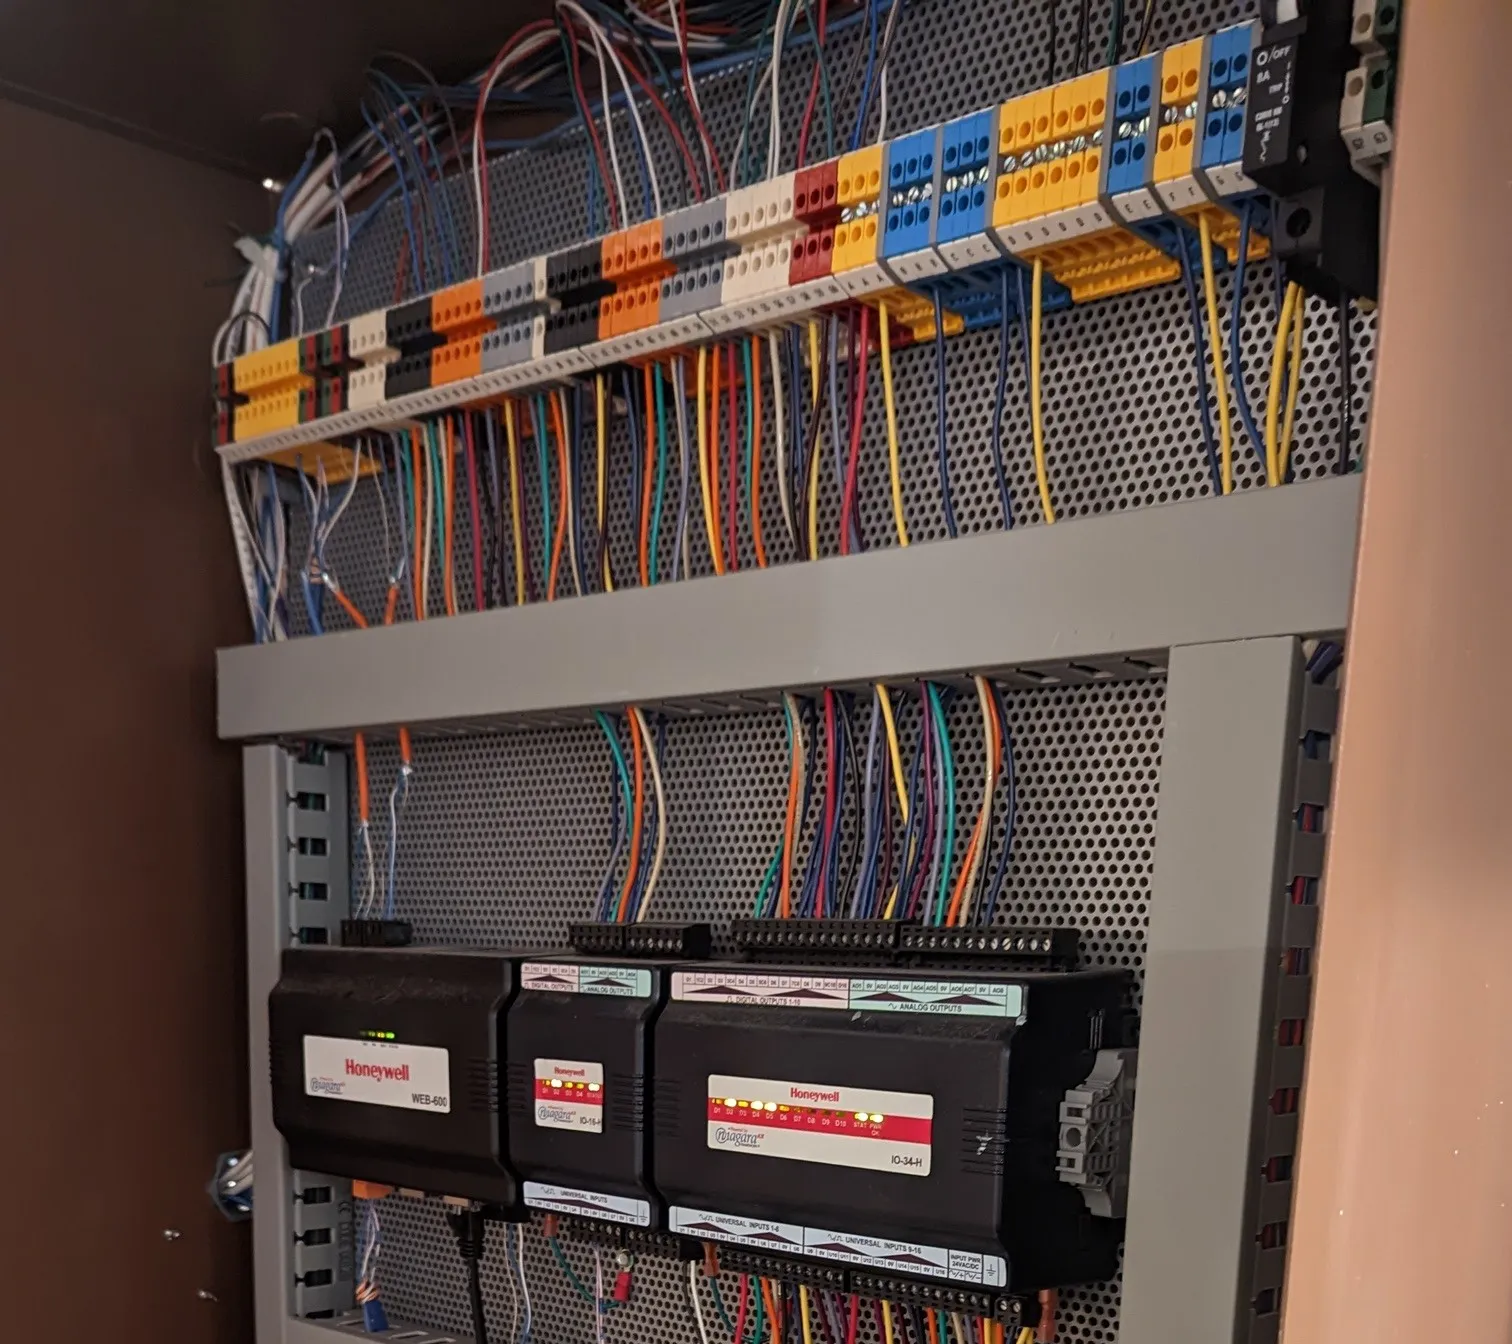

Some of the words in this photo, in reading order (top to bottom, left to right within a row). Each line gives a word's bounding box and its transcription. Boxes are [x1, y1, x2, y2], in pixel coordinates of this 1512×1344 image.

[736, 996, 758, 1004] DIGITAL
[760, 997, 788, 1005] OUTPUTS
[900, 1004, 928, 1012] ANALOG
[930, 1004, 962, 1012] OUTPUTS
[345, 1058, 410, 1082] Honeywell
[554, 1066, 585, 1076] Honeywell
[412, 1093, 448, 1107] WEB-600
[790, 1087, 840, 1102] Honeywell
[766, 1112, 774, 1120] D5
[780, 1113, 788, 1121] D6
[835, 1119, 846, 1127] D10
[716, 1128, 757, 1146] niagara
[891, 1155, 922, 1167] IO-34-H
[560, 1190, 588, 1200] UNIVERSAL
[590, 1194, 608, 1203] INPUTS
[715, 1217, 746, 1227] UNIVERSAL
[749, 1222, 769, 1231] INPUTS
[845, 1236, 881, 1248] UNIVERSAL
[884, 1243, 907, 1252] INPUTS
[950, 1254, 967, 1262] INPUT
[968, 1256, 981, 1264] PWR
